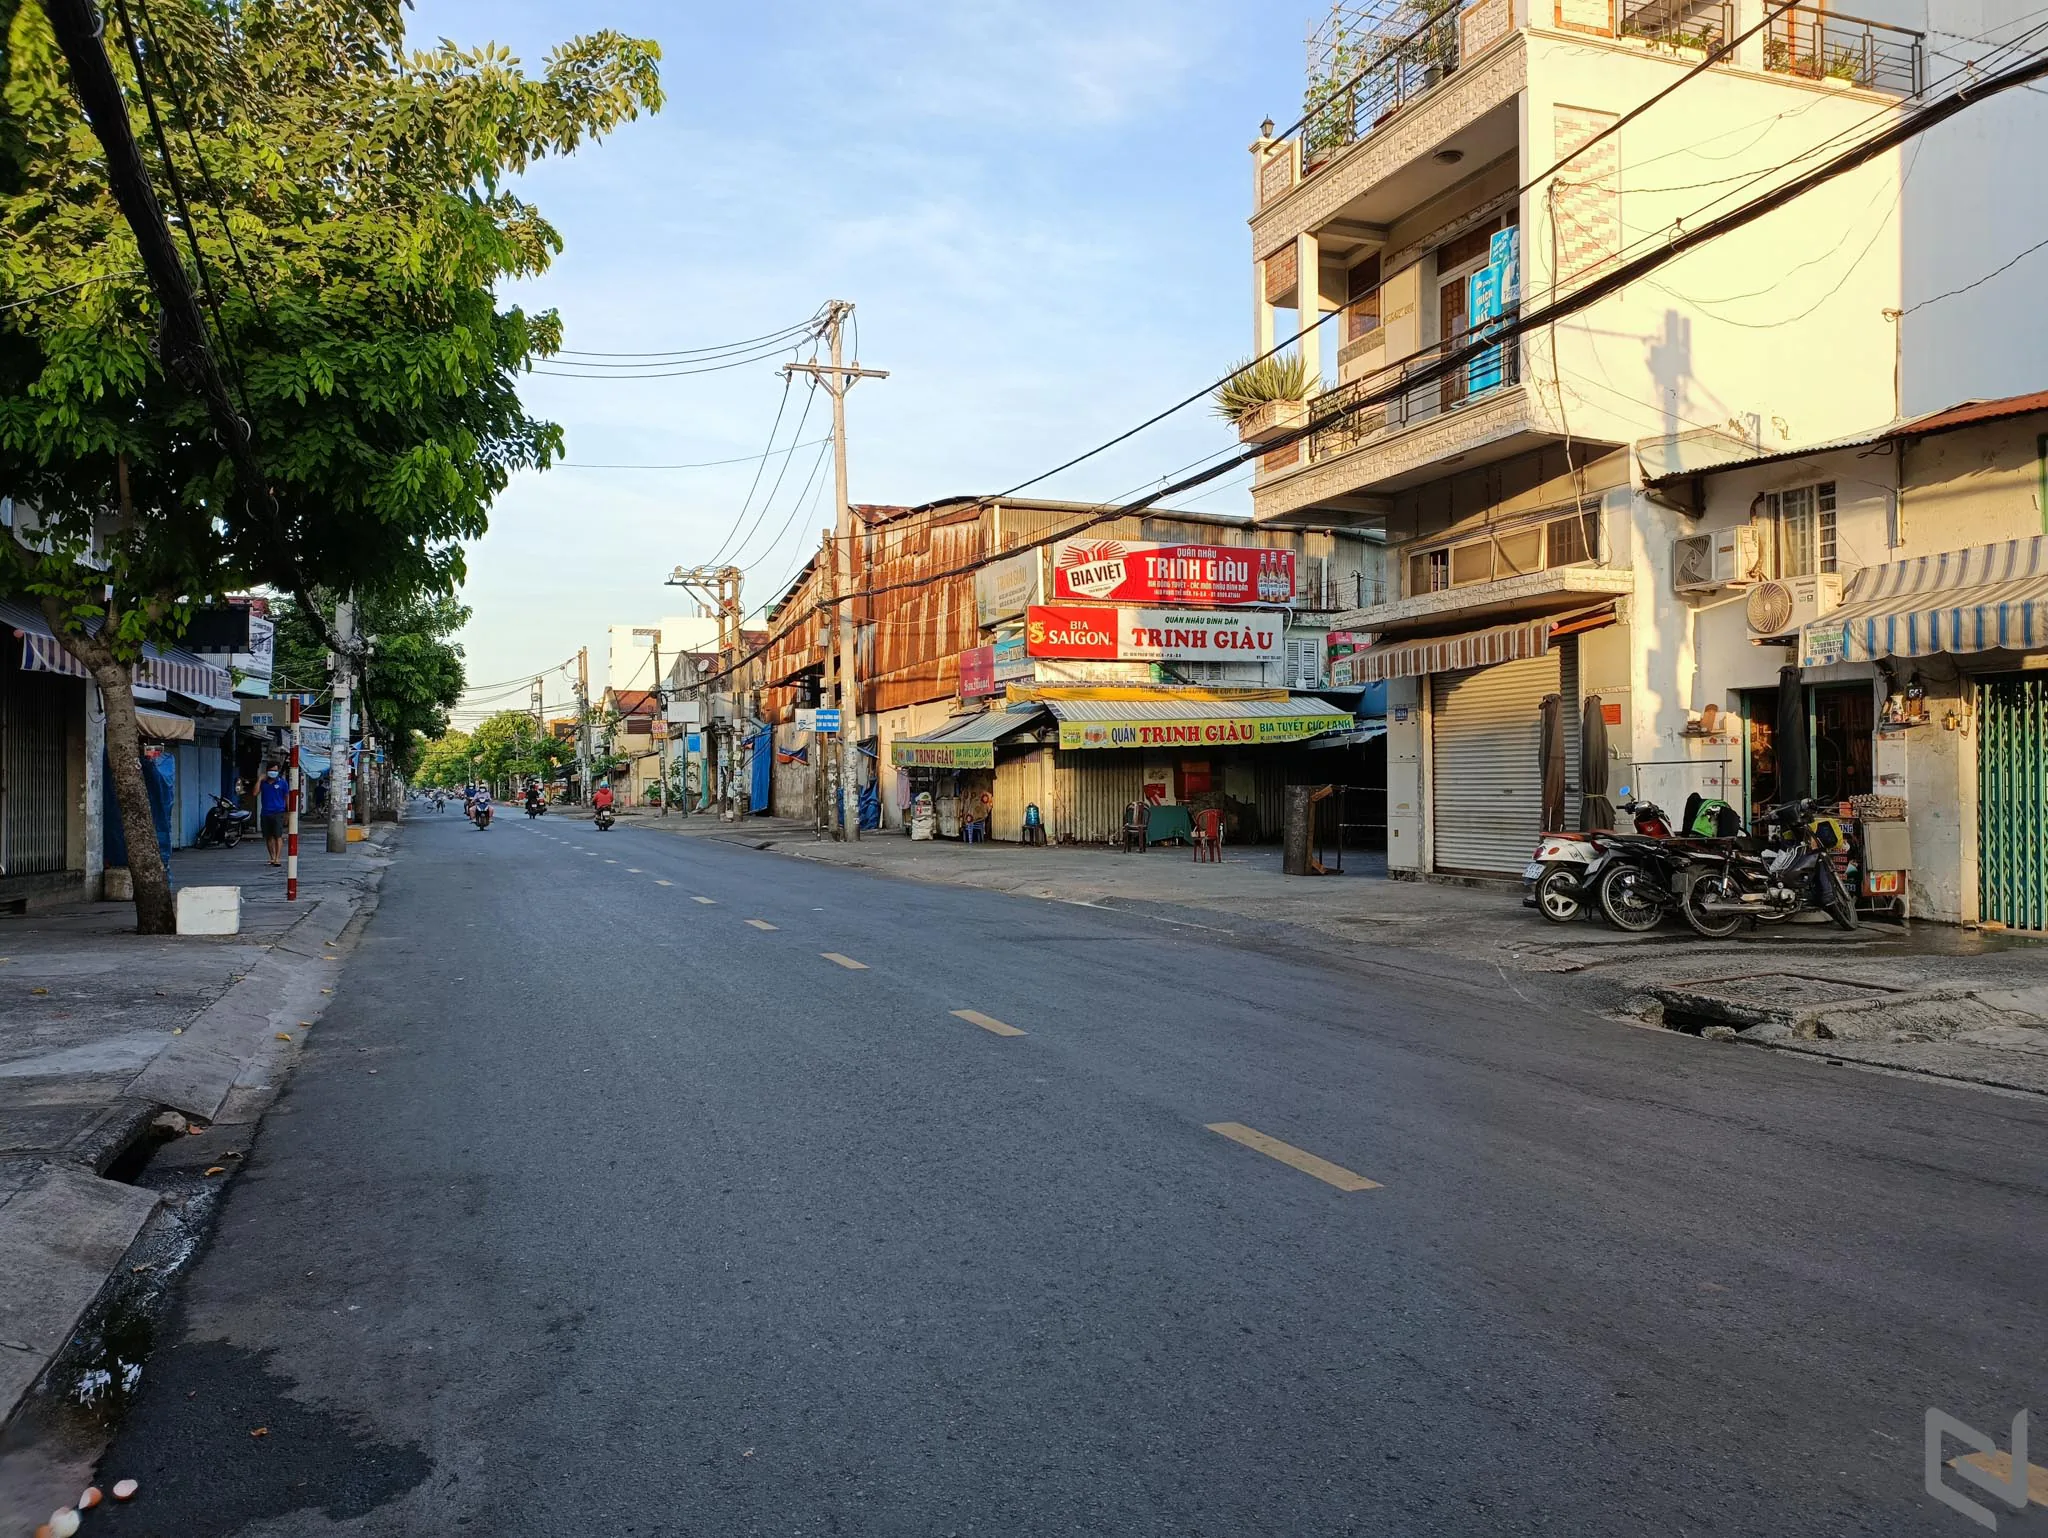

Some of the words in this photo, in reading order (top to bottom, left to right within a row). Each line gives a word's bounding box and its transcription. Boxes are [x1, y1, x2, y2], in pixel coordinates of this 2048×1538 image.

[1177, 547, 1196, 558] QUÁN
[1197, 548, 1217, 560] NHẬU
[1070, 568, 1095, 587] BIA
[1093, 562, 1121, 583] VIỆT
[1145, 557, 1200, 580] TRINH
[1206, 556, 1248, 582] GIÀU
[1070, 621, 1089, 630] BIA
[1164, 615, 1185, 624] QUÁN
[1206, 616, 1224, 625] BÌNH
[1224, 617, 1240, 625] DÂN
[1049, 629, 1111, 646] SAIGON
[1131, 627, 1209, 649] TRINH
[1213, 625, 1275, 650] GIÀU
[1111, 723, 1136, 744] QUÁN
[1139, 726, 1201, 744] TRINH
[1205, 720, 1254, 743] GIÀU
[1260, 722, 1274, 732] BIA
[1277, 718, 1305, 732] TUYẾT
[915, 748, 936, 763] TRINH
[936, 745, 954, 765] GIÀU
